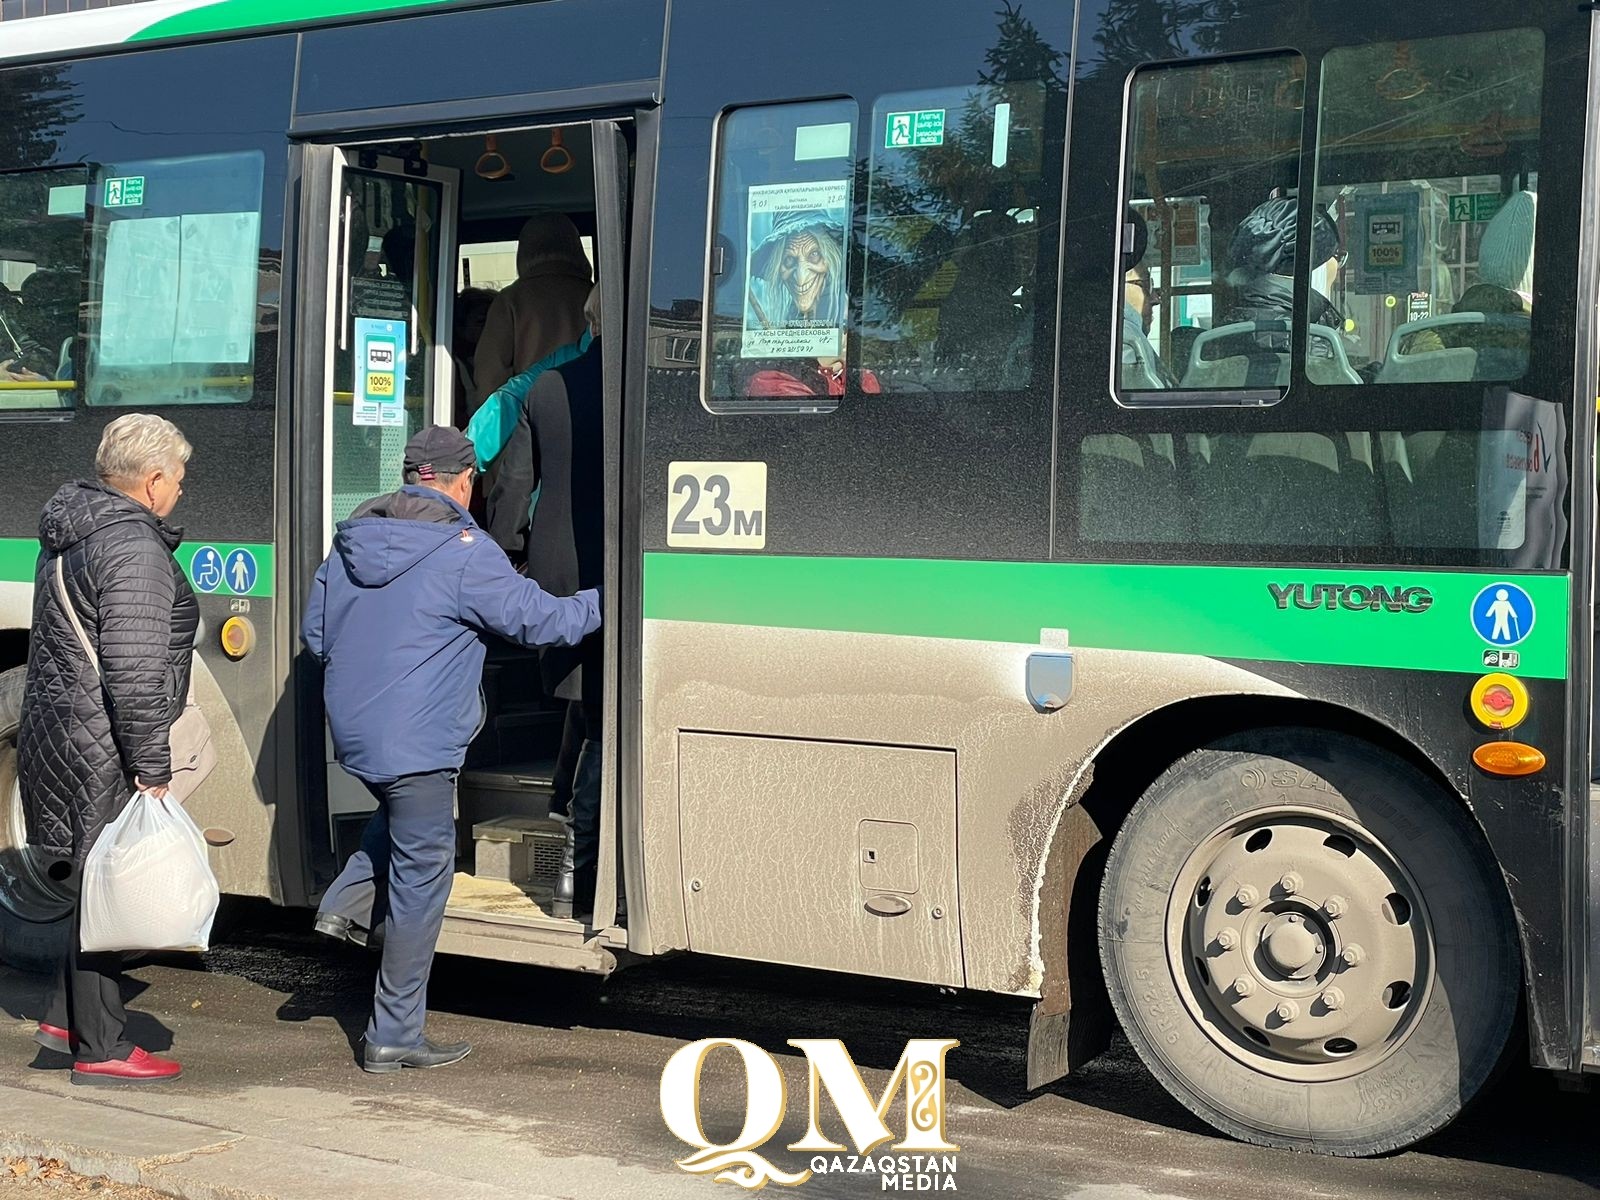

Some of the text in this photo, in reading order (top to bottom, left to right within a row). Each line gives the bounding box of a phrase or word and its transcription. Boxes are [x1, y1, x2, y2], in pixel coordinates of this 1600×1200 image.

[777, 329, 831, 337] СРЕДНЕВЕКОВЬЯ
[370, 376, 391, 386] 100%
[1267, 583, 1433, 613] YUTONG
